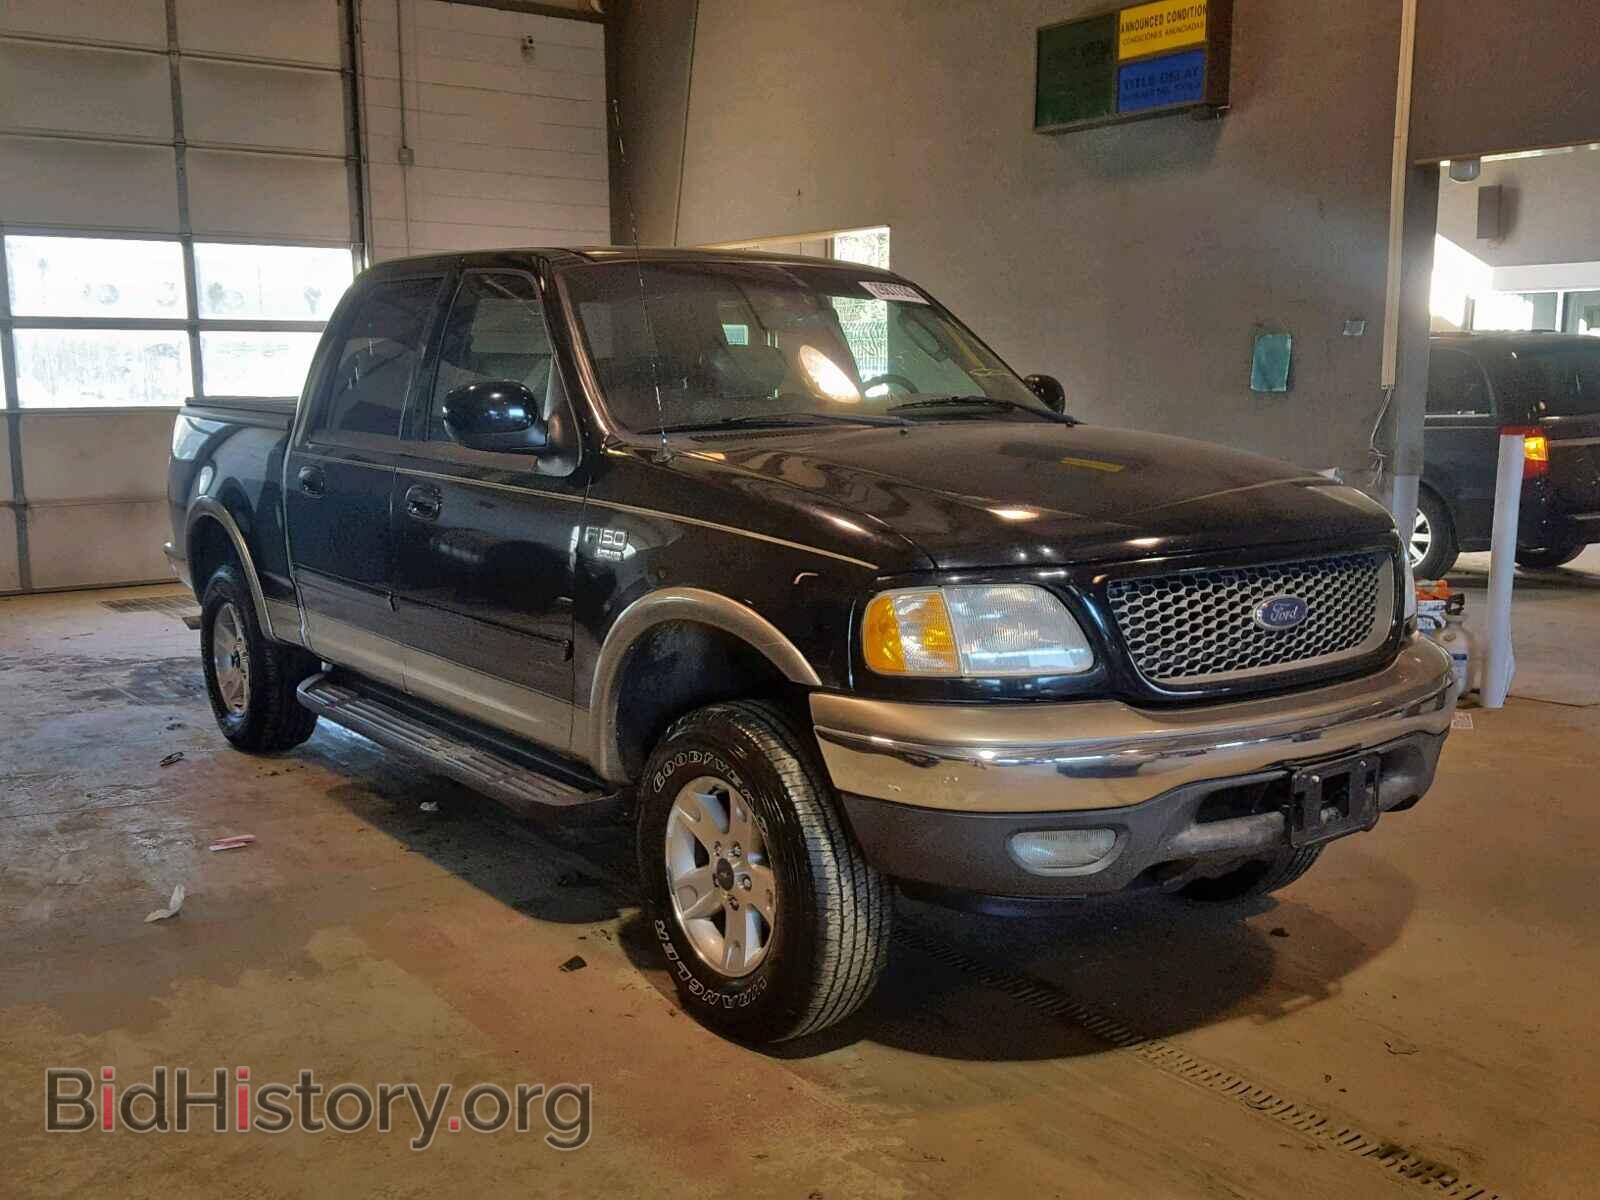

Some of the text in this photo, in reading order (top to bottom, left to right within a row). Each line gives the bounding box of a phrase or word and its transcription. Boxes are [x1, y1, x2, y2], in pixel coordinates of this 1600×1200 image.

[1120, 13, 1164, 33] ANNOUNCED
[1270, 603, 1299, 622] Ford
[654, 919, 768, 1009] WRANGLER
